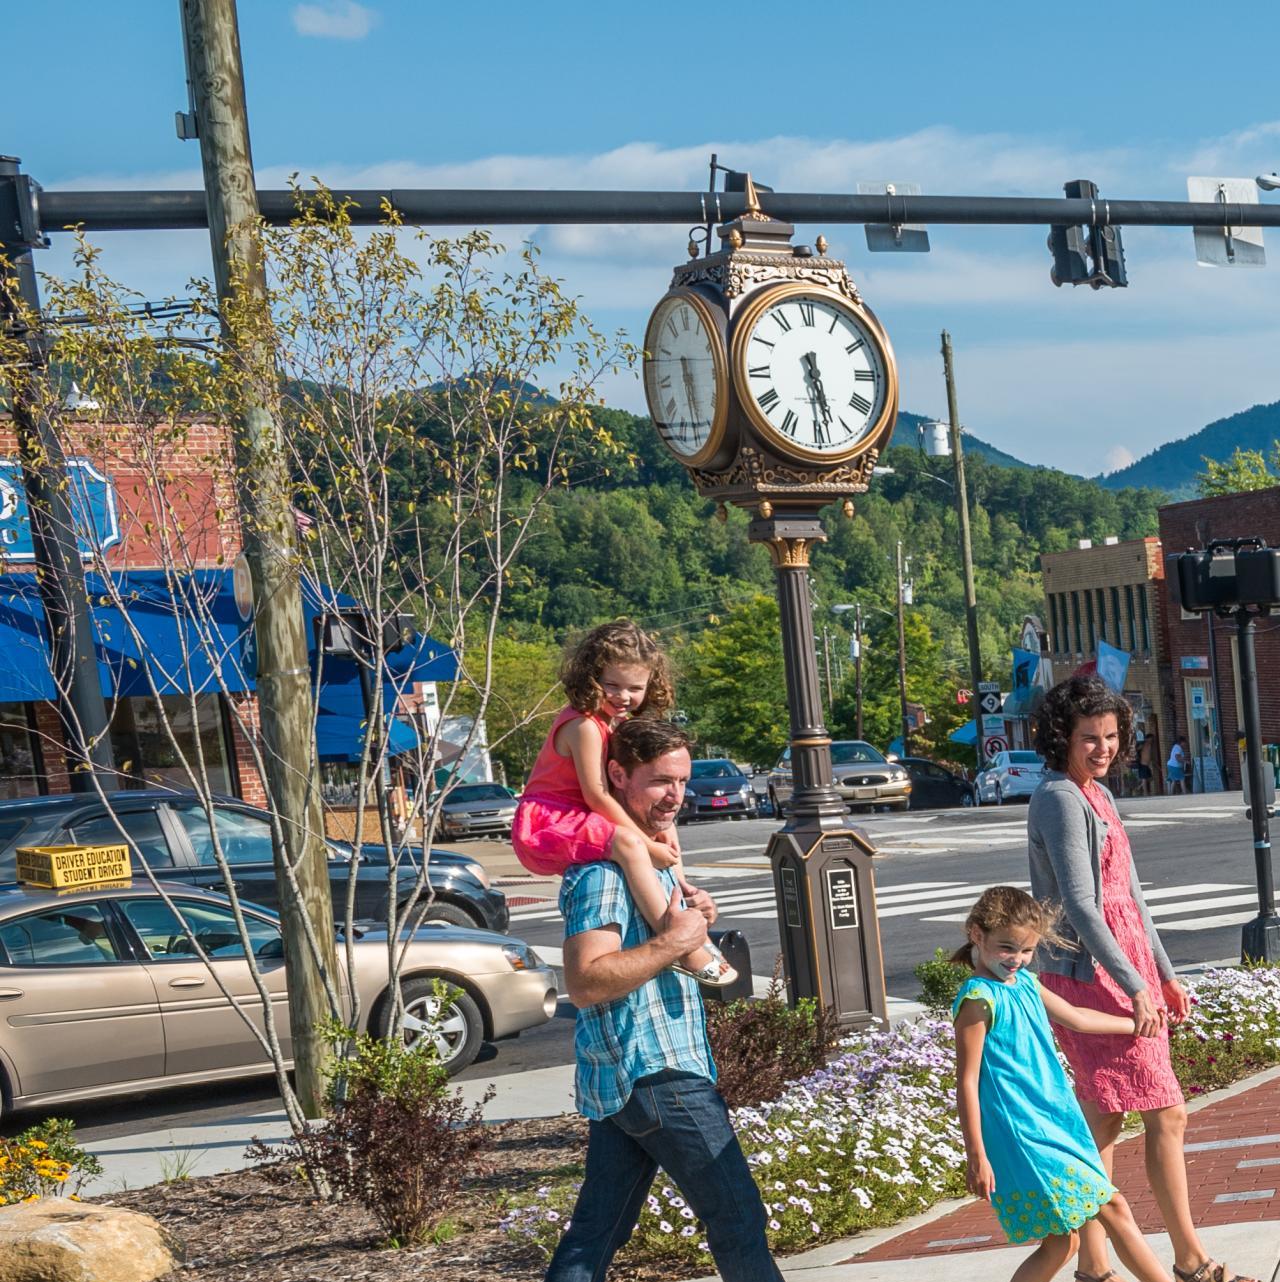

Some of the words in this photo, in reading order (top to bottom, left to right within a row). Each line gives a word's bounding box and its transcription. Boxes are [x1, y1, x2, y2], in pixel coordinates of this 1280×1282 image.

[987, 698, 996, 710] 9
[55, 853, 84, 870] DRIVER
[86, 848, 127, 866] EDUCATION
[63, 867, 97, 883] STUDENT
[98, 863, 124, 879] DRIVER
